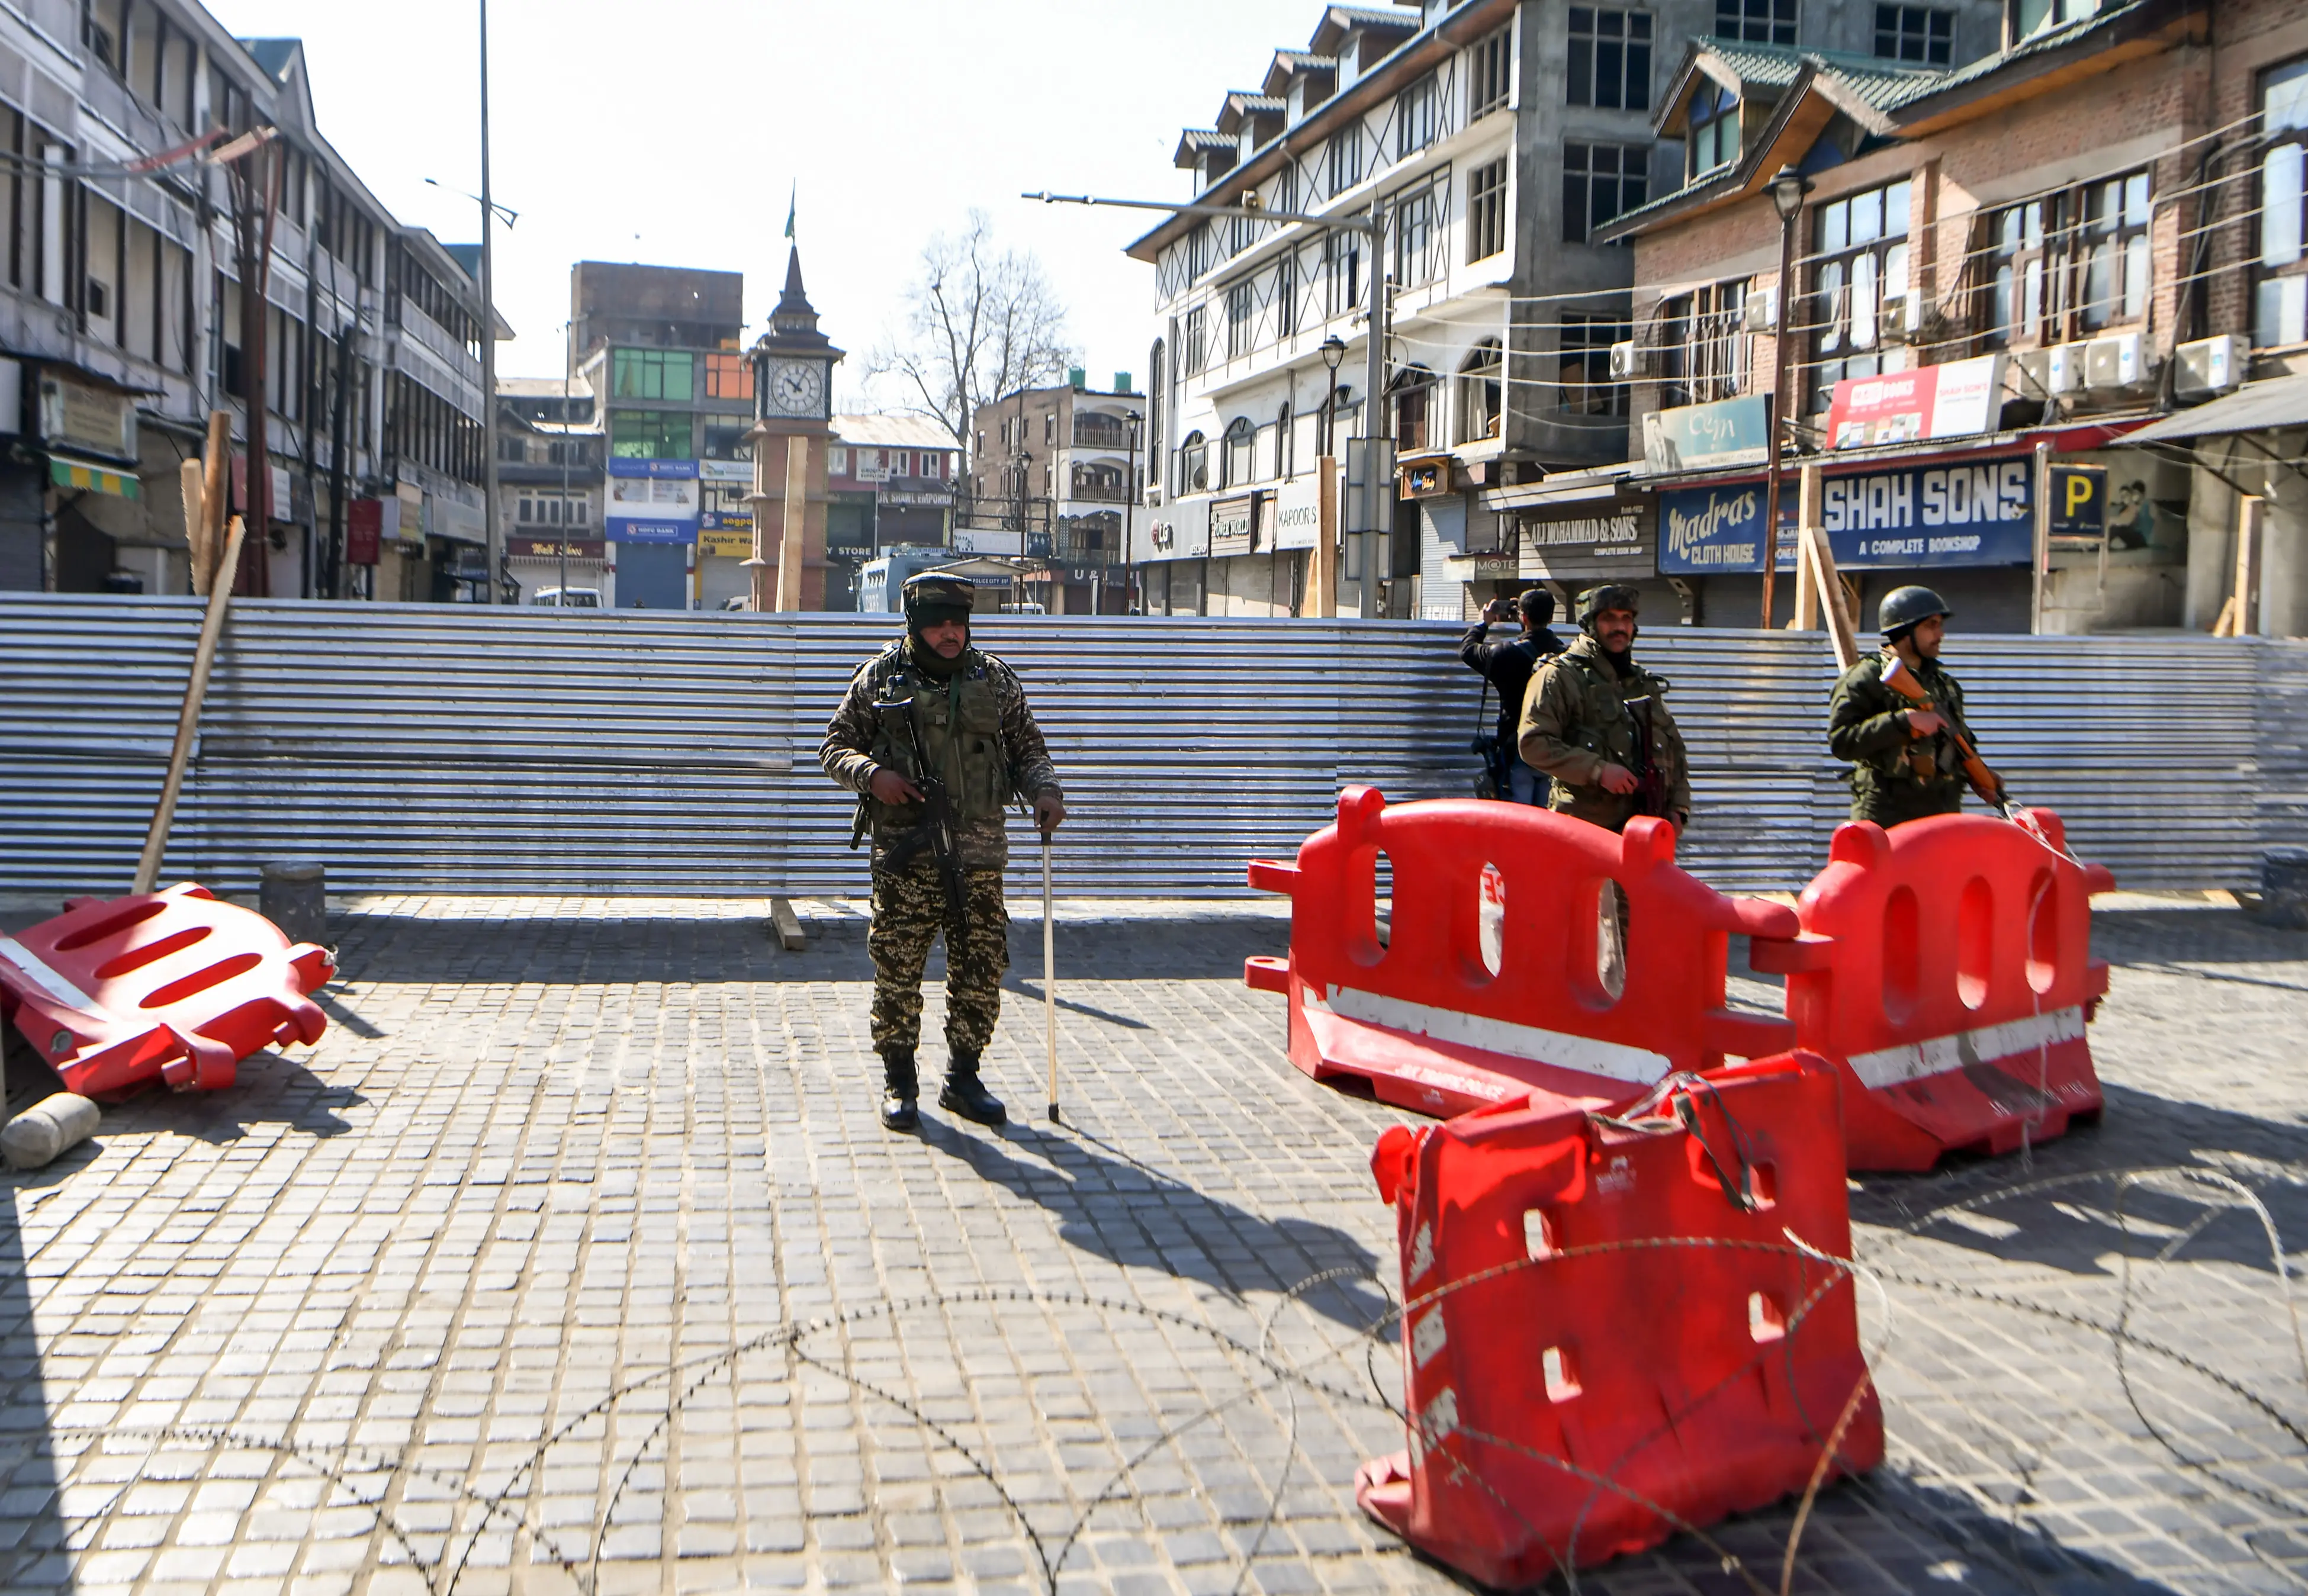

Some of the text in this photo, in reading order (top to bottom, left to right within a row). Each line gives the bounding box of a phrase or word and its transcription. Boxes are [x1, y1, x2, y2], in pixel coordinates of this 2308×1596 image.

[891, 492, 915, 504] SHAWL
[1825, 462, 2026, 532] SHAH SONS
[2065, 475, 2094, 517] P
[1230, 518, 1249, 536] WORLD
[1278, 507, 1310, 528] KAPOOR
[1668, 490, 1756, 561] Madras
[703, 535, 736, 544] Kashir
[1547, 517, 1599, 545] MOHAMMAD
[1600, 517, 1610, 543] &
[1611, 515, 1638, 542] SONS
[838, 547, 871, 555] STORE
[1691, 543, 1756, 564] CLOTH HOUSE
[1859, 535, 1981, 556] A COMPLETE BOOKSHOP
[1074, 569, 1084, 580] U
